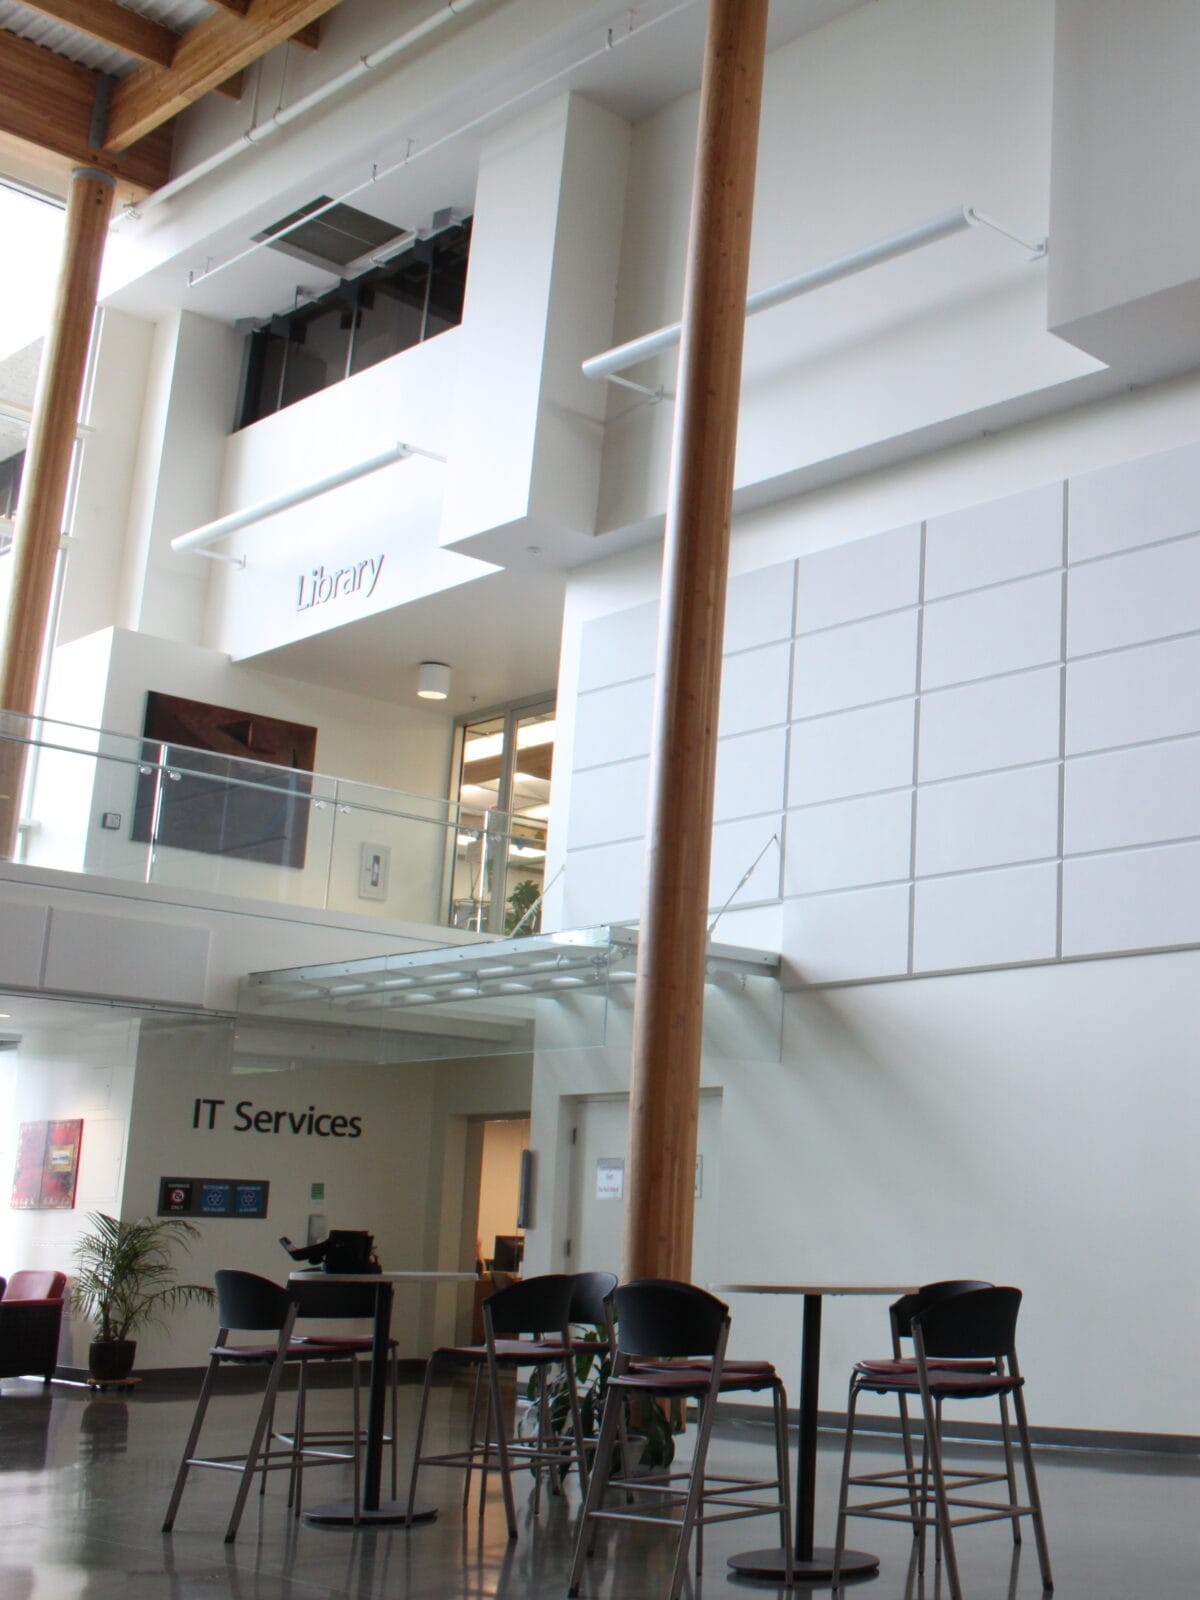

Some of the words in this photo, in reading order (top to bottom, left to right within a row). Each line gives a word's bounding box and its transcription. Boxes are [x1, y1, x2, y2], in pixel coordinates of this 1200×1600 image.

[296, 554, 385, 612] Library
[193, 1098, 225, 1130] IT
[233, 1101, 362, 1138] Services
